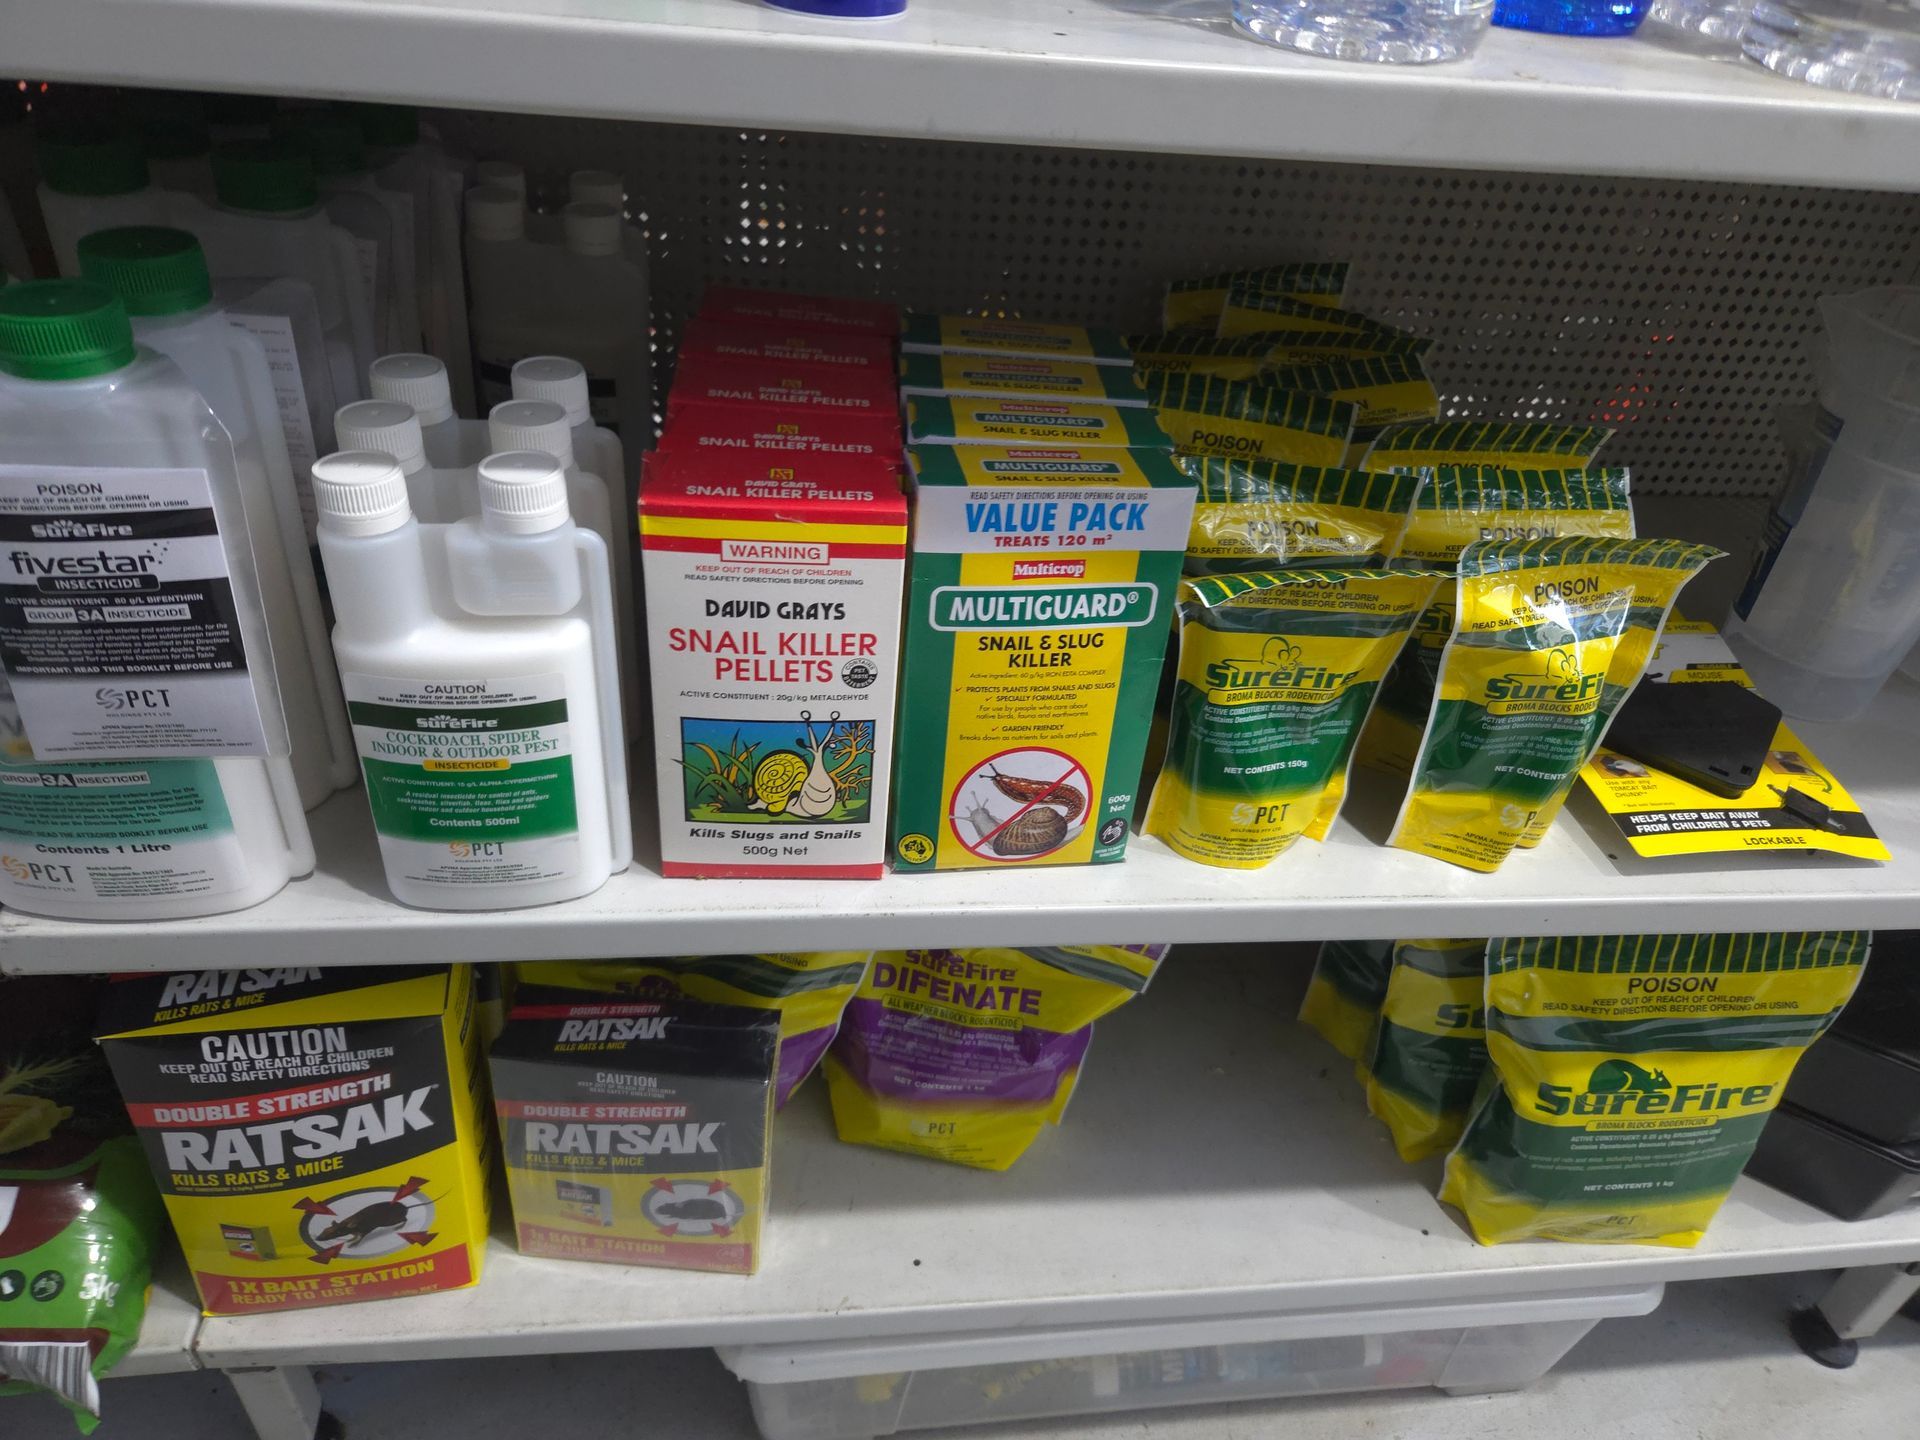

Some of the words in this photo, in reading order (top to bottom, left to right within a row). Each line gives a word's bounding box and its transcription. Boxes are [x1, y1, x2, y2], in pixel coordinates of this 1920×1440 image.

[984, 413, 1094, 426] MULTIGUARD
[699, 437, 750, 448] SNAIL
[754, 440, 807, 450] KILLER
[812, 443, 873, 454] PELLETS
[1192, 430, 1263, 453] POISON
[995, 463, 1101, 472] MULTIGUARD
[36, 483, 103, 496] POISON
[686, 485, 741, 497] SNAIL
[746, 488, 802, 499] KILLER
[807, 490, 874, 501] PELLETS
[965, 503, 1058, 533] VALUE
[1069, 503, 1149, 531] PACK
[31, 522, 133, 538] SureFire
[1247, 520, 1320, 537] POISON
[994, 535, 1050, 547] TREATS
[1057, 535, 1087, 546] 120
[729, 545, 821, 560] WARNING
[8, 550, 155, 575] fivestar
[1014, 562, 1084, 577] Multicrop
[743, 566, 755, 574] OF
[758, 567, 789, 575] REACH
[806, 568, 852, 577] CHILDREN
[54, 578, 141, 590] INSECTICIDE
[1534, 576, 1599, 602] POISON
[29, 611, 72, 620] GROUP
[78, 609, 104, 621] 3A
[108, 607, 187, 619] INSECTICIDE
[705, 599, 770, 619] DAVID
[777, 601, 846, 621] GRAYS
[669, 628, 767, 655] SNAIL
[778, 631, 878, 656] KILLER
[978, 636, 1033, 651] SNAIL
[1039, 635, 1052, 650] &
[1057, 633, 1104, 650] SLUG
[1008, 653, 1072, 668] KILLER
[715, 657, 833, 683] PELLETS
[1205, 663, 1358, 688] SureFire
[1688, 671, 1723, 679] MOUSE
[424, 684, 486, 694] CAUTION
[680, 690, 710, 699] ACTIVE
[713, 692, 770, 700] CONSTITUENT
[776, 693, 807, 702] 20g/kg
[810, 693, 869, 702] METALDEHYDE
[1226, 691, 1253, 702] BROMA
[1255, 690, 1284, 699] BLOCKS
[126, 689, 171, 708] PCT
[416, 718, 499, 729] SureFire
[386, 731, 486, 747] COCKROACH,
[488, 729, 540, 745] SPIDER
[372, 741, 427, 758] INDOOR
[432, 747, 443, 758] &
[447, 744, 521, 759] OUTDOOR
[525, 738, 559, 755] PEST
[434, 760, 499, 769] INSECTICIDE
[1223, 766, 1243, 774] NET
[1245, 761, 1285, 774] CONTENTS
[1287, 760, 1309, 768] 150g
[42, 773, 74, 787] 3A
[76, 773, 148, 785] INSECTICIDE
[1254, 803, 1291, 824] PCT
[1630, 814, 1667, 824] HELPS
[1669, 812, 1698, 822] KEEP
[1700, 811, 1728, 820] BAIT
[1729, 811, 1760, 820] AWAY
[430, 817, 482, 828] Contents
[485, 816, 520, 827] 500ml
[1636, 824, 1671, 834] FROM
[1672, 821, 1729, 832] CHILDREN
[1732, 820, 1741, 829] &
[1743, 819, 1771, 828] PETS
[690, 828, 725, 838] Kills
[731, 830, 774, 841] Slugs
[780, 831, 809, 840] and
[814, 830, 861, 840] Snails
[1743, 836, 1807, 846] LOCKABLE
[35, 843, 109, 854] Contents
[116, 844, 125, 853] 1
[131, 843, 172, 853] Litre
[471, 841, 505, 857] PCT
[743, 846, 778, 857] 500g
[783, 846, 808, 855] Net
[28, 862, 74, 884] PCT
[905, 949, 1017, 982] SureFire
[159, 967, 322, 1008] RATSAK
[872, 961, 1042, 1016] DIFENATE
[1627, 977, 1719, 993] POISON
[154, 1006, 188, 1022] KILLS
[190, 999, 221, 1015] RATS
[222, 998, 231, 1009] &
[235, 992, 266, 1007] MICE
[1542, 1002, 1568, 1011] READ
[1571, 1003, 1610, 1015] SAFETY
[1613, 1005, 1666, 1015] DIRECTIONS
[1669, 1004, 1708, 1013] BEFORE
[1709, 1003, 1751, 1012] OPENING
[1753, 1002, 1766, 1010] OR
[1768, 1001, 1798, 1010] USING
[1592, 998, 1618, 1007] KEEP
[1621, 997, 1639, 1005] OUT
[1640, 996, 1653, 1005] OF
[1656, 995, 1690, 1004] REACH
[1691, 995, 1704, 1003] OF
[1706, 994, 1755, 1004] CHILDREN
[570, 1006, 608, 1017] DOUBLE
[609, 1004, 661, 1015] STRENGTH
[887, 997, 901, 1008] ALL
[903, 999, 939, 1017] WEATHER
[939, 1007, 967, 1024] BLOCKS
[969, 1014, 1019, 1029] RODENTICIDE
[557, 1016, 672, 1042] RATSAK
[201, 1027, 348, 1062] CAUTION
[160, 1063, 196, 1074] KEEP
[200, 1062, 229, 1073] OUT
[232, 1061, 252, 1072] OF
[255, 1057, 301, 1071] REACH
[305, 1053, 323, 1065] OF
[326, 1046, 394, 1064] CHILDREN
[189, 1072, 228, 1084] READ
[232, 1069, 284, 1082] SAFETY
[289, 1060, 371, 1078] DIRECTIONS
[596, 1072, 657, 1088] CAUTION
[154, 1102, 250, 1123] DOUBLE
[257, 1073, 391, 1115] STRENGTH
[1535, 1082, 1776, 1116] SureFire
[523, 1105, 589, 1118] DOUBLE
[595, 1106, 688, 1119] STRENGTH
[161, 1085, 435, 1171] RATSAK
[928, 1122, 956, 1134] PCT
[525, 1121, 721, 1155] RATSAK
[526, 1153, 560, 1164] KILLS
[562, 1154, 594, 1165] RATS
[598, 1156, 608, 1166] &
[611, 1156, 645, 1167] MICE
[172, 1172, 219, 1187] KILLS
[224, 1169, 271, 1185] RATS
[275, 1168, 290, 1180] &
[294, 1156, 344, 1178] MICE
[1606, 1215, 1639, 1225] PCT
[263, 1279, 321, 1293] BAIT
[329, 1258, 435, 1288] STATION
[232, 1294, 288, 1305] READY
[295, 1291, 317, 1301] TO
[320, 1287, 357, 1299] USE
